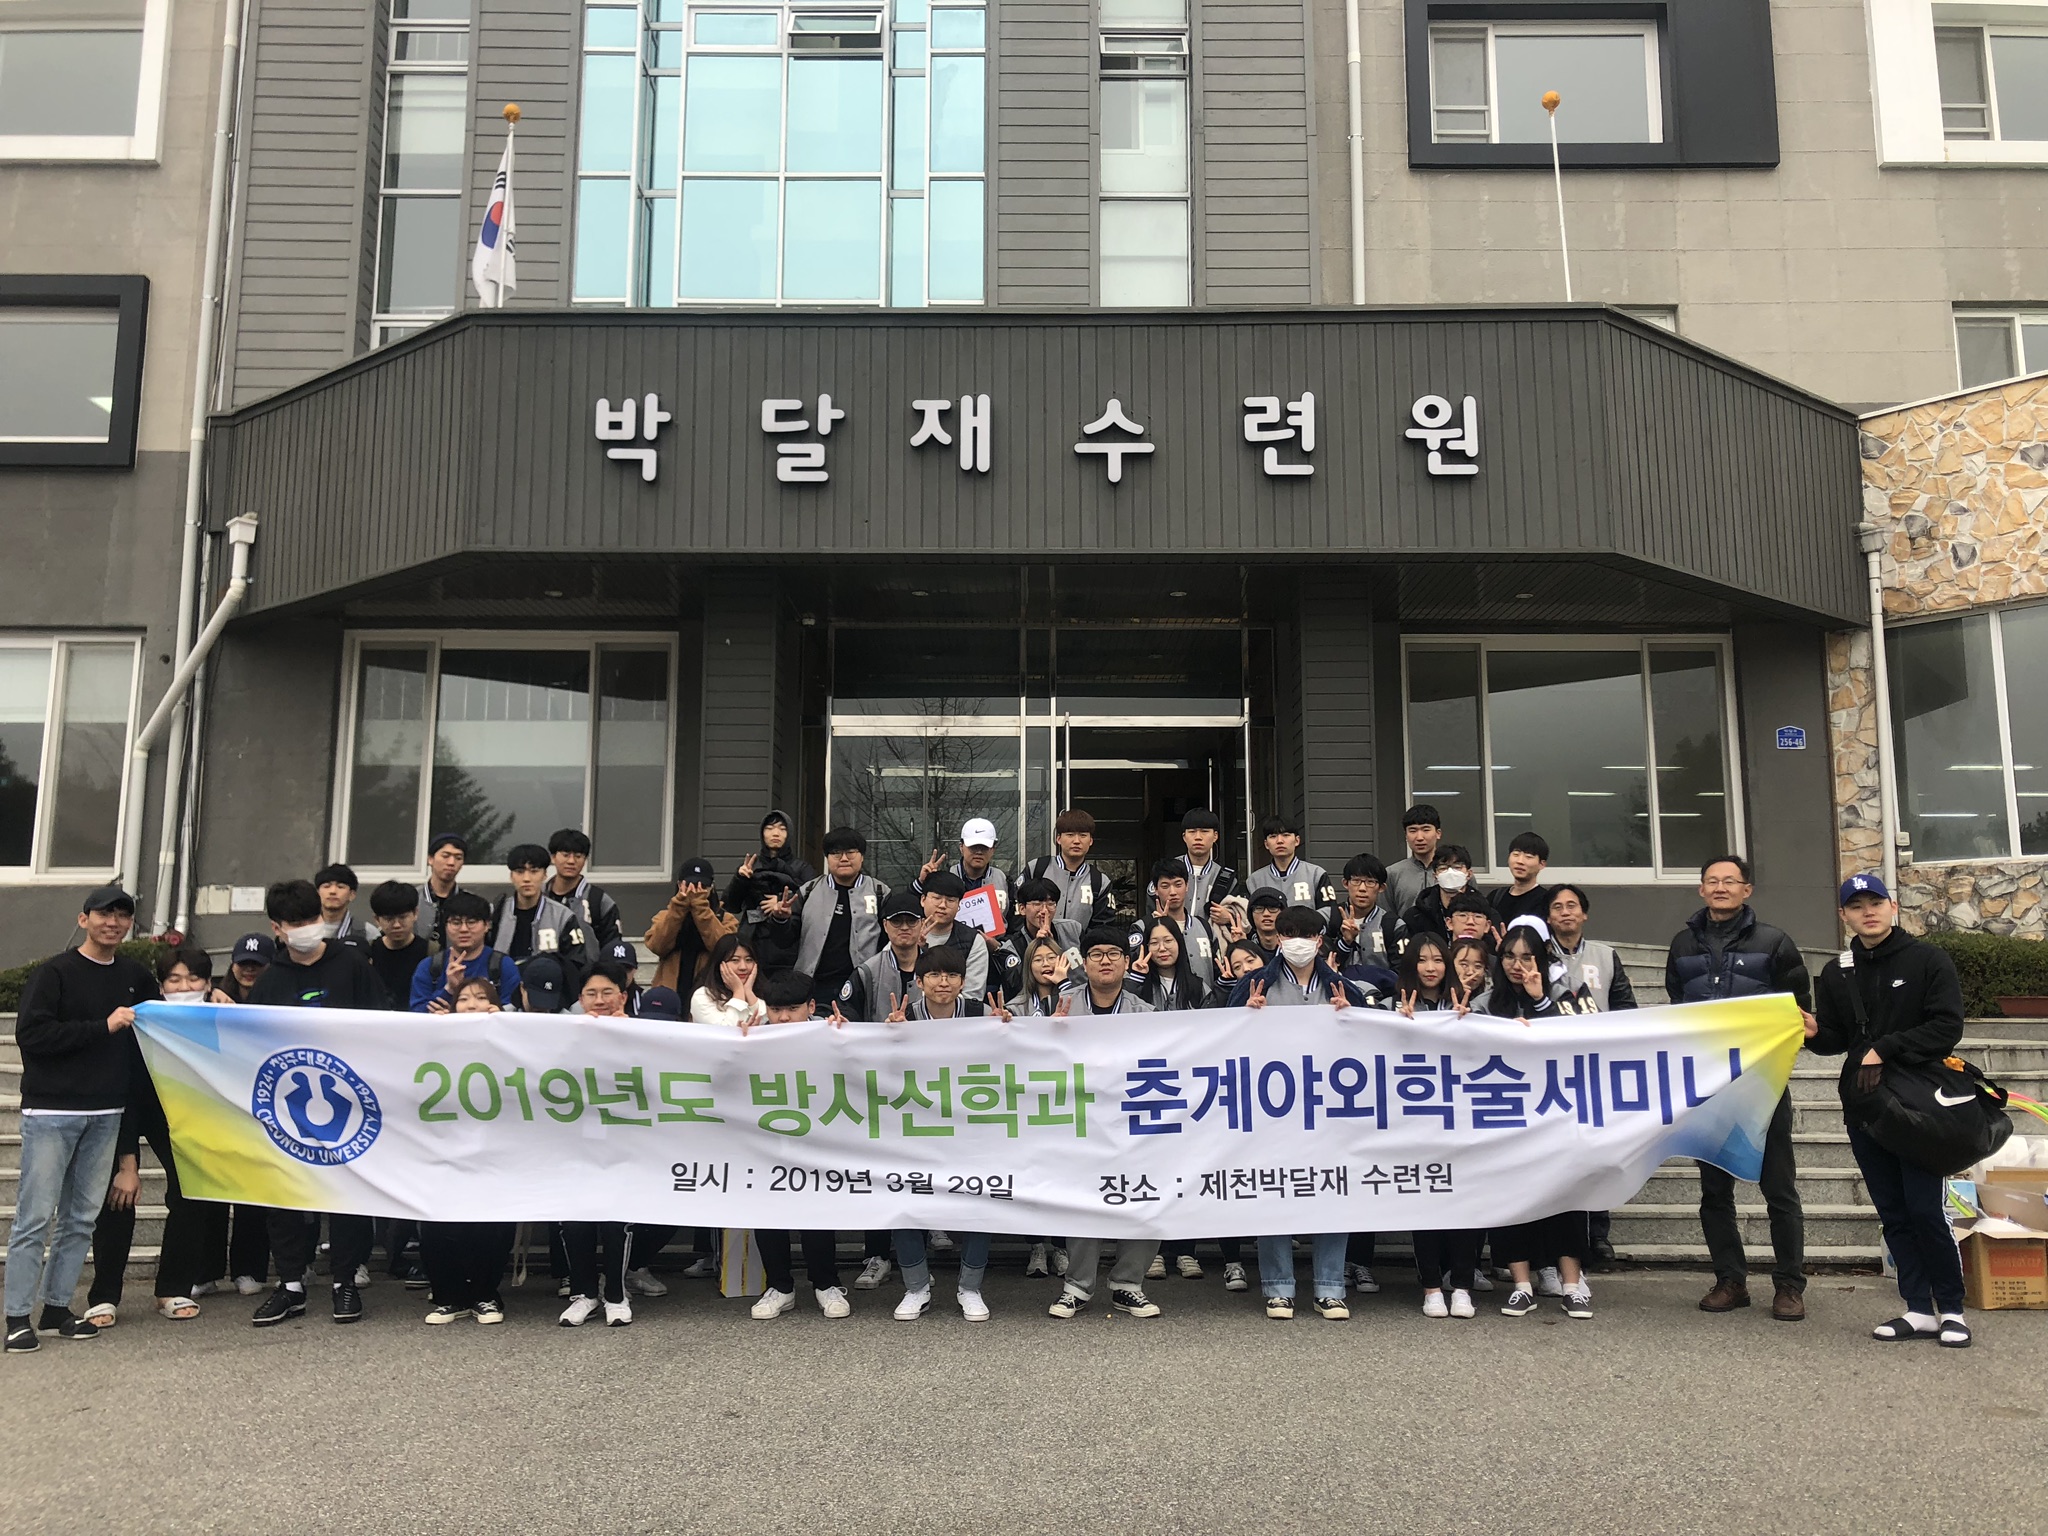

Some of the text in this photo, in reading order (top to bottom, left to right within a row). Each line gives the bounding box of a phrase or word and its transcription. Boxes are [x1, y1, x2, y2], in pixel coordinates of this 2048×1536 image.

[594, 391, 1480, 484] 박달재수련원
[1293, 881, 1311, 901] R
[1320, 885, 1337, 902] 19
[1852, 876, 1868, 890] LA
[538, 927, 559, 951] R
[613, 945, 626, 958] NY
[1196, 937, 1213, 958] R
[1582, 963, 1601, 989] R
[1578, 996, 1599, 1014] 19
[269, 1050, 348, 1078] 청주대학교
[256, 1073, 275, 1105] 1924
[355, 1083, 378, 1112] 1947
[413, 1061, 726, 1128] 2019년도
[749, 1062, 1096, 1139] 방사선학과
[318, 1113, 379, 1163] UNVERSITY
[671, 1161, 729, 1193] 일시
[769, 1165, 873, 1194] 2019년
[885, 1171, 935, 1195] 3월
[947, 1173, 1014, 1201] 29일
[1098, 1173, 1161, 1206] 장소
[1199, 1164, 1348, 1201] 제천박달재
[1360, 1162, 1454, 1196] 수련원
